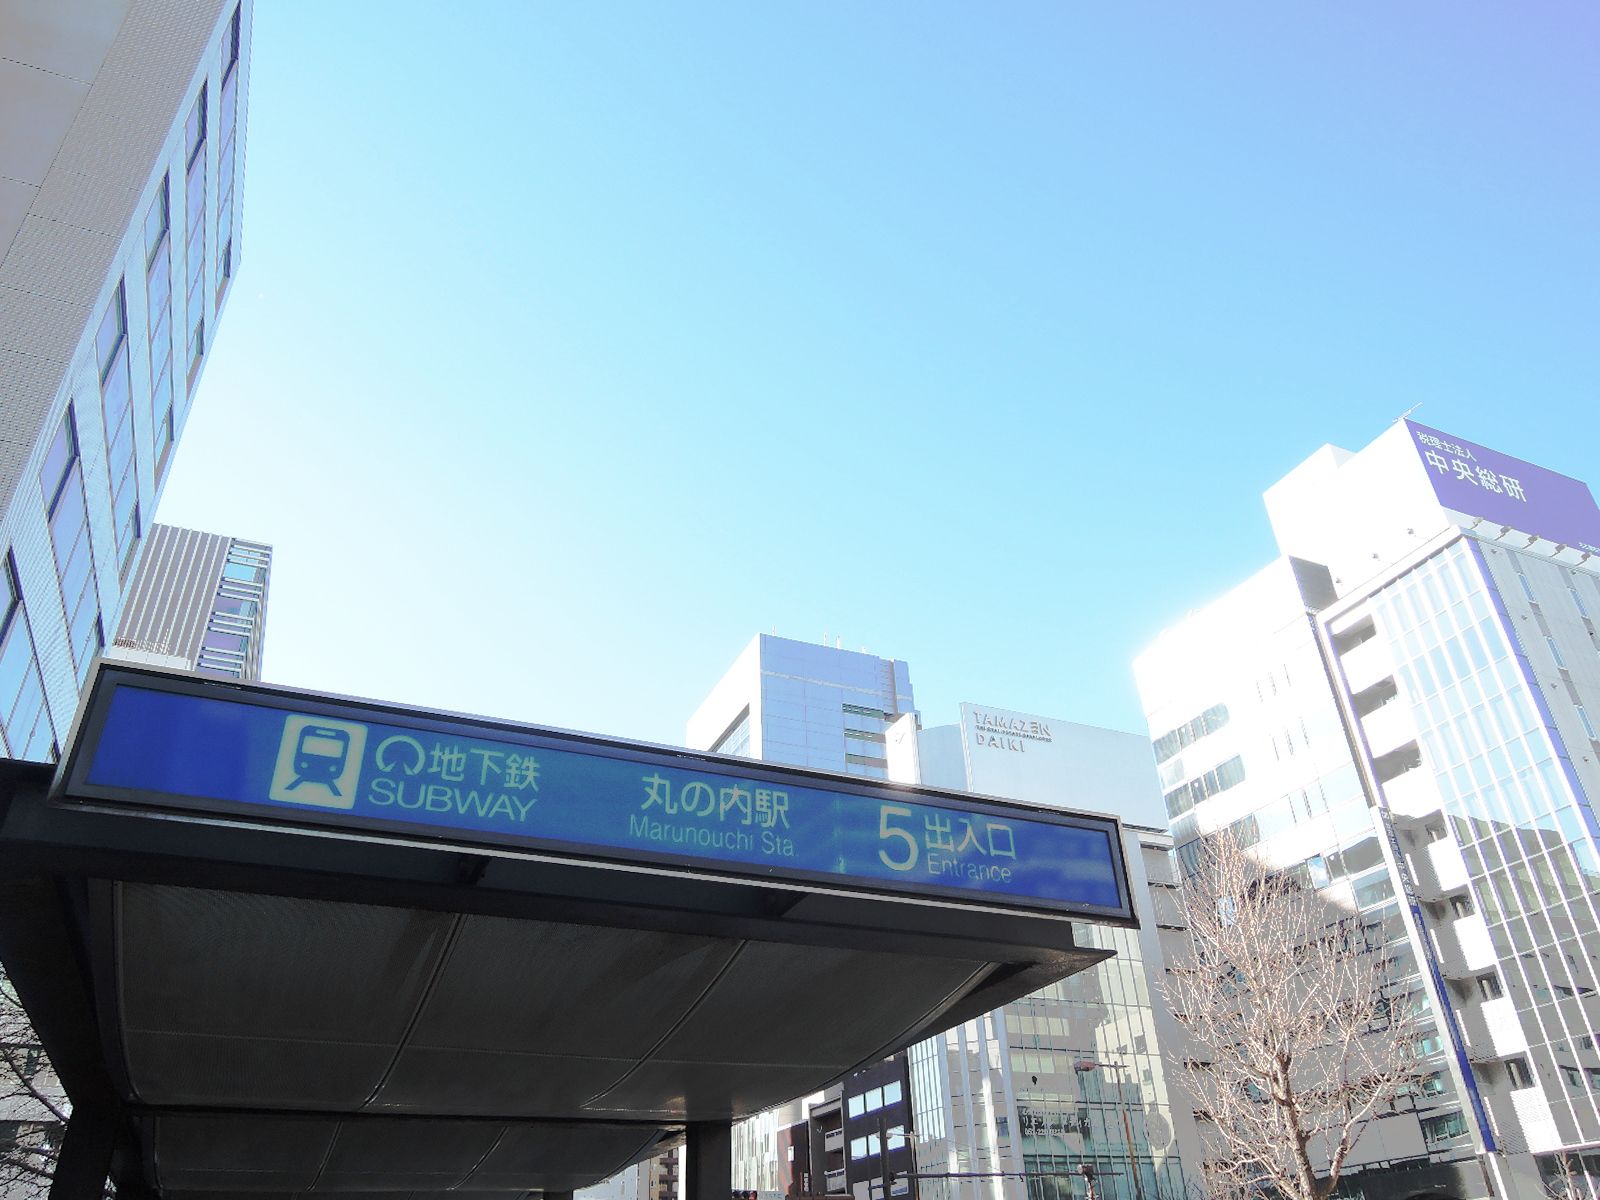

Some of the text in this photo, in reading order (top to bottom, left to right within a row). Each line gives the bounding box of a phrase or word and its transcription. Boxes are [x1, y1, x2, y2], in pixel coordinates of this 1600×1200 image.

[1417, 431, 1477, 462] 税理士法人
[1425, 449, 1526, 502] 中央総研
[976, 733, 1025, 752] DAIKI
[427, 742, 540, 792] 地下鉄
[368, 778, 537, 822] SUBWAY
[641, 772, 790, 829] 丸の内駅
[629, 813, 753, 850] Marunouchi
[879, 804, 919, 871] 5
[924, 813, 1016, 859] 出入口
[927, 853, 1012, 883] Entrance
